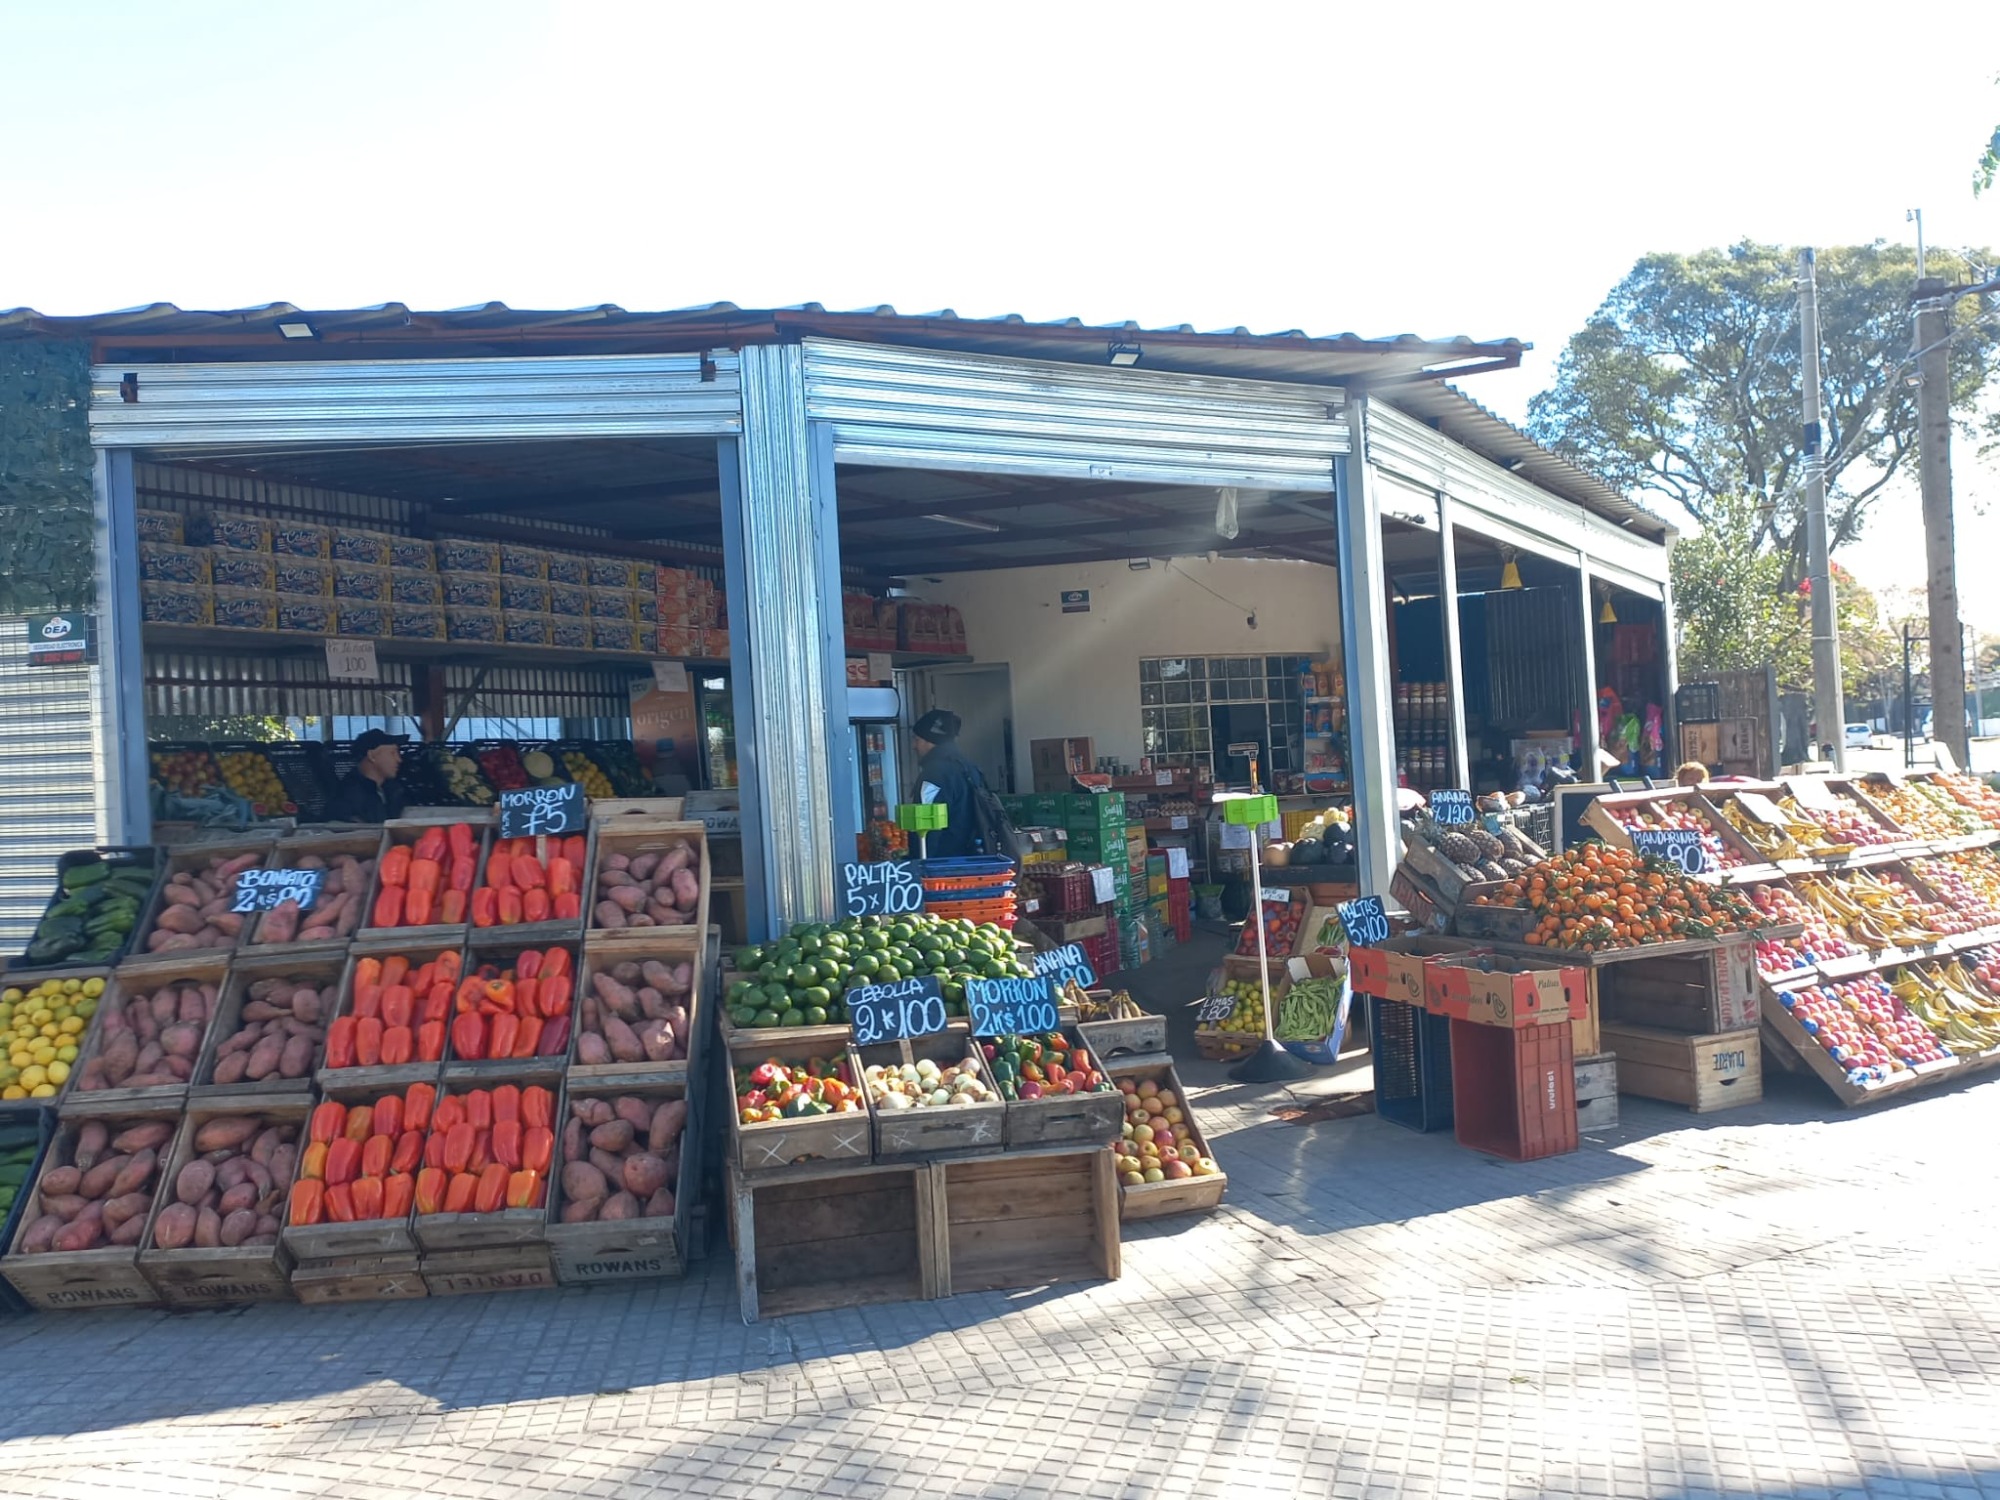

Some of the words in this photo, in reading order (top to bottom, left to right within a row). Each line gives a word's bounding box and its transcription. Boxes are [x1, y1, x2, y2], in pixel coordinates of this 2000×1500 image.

[44, 625, 68, 634] DEA
[637, 706, 690, 729] origen
[501, 784, 576, 809] MORRON
[1432, 790, 1472, 804] ANANA
[1633, 830, 1702, 846] MANDARINAS
[844, 860, 913, 887] PALTAS
[1337, 897, 1380, 922] PALTAS
[846, 978, 924, 1006] CEBOLLA
[967, 977, 1048, 1006] MORRON
[1203, 995, 1235, 1008] LIMAS
[1712, 1049, 1745, 1071] DUARTE
[576, 1259, 662, 1276] ROWANS
[183, 1283, 271, 1298] ROWANS
[443, 1271, 544, 1291] DANIEL
[47, 1287, 139, 1304] ROWANS
